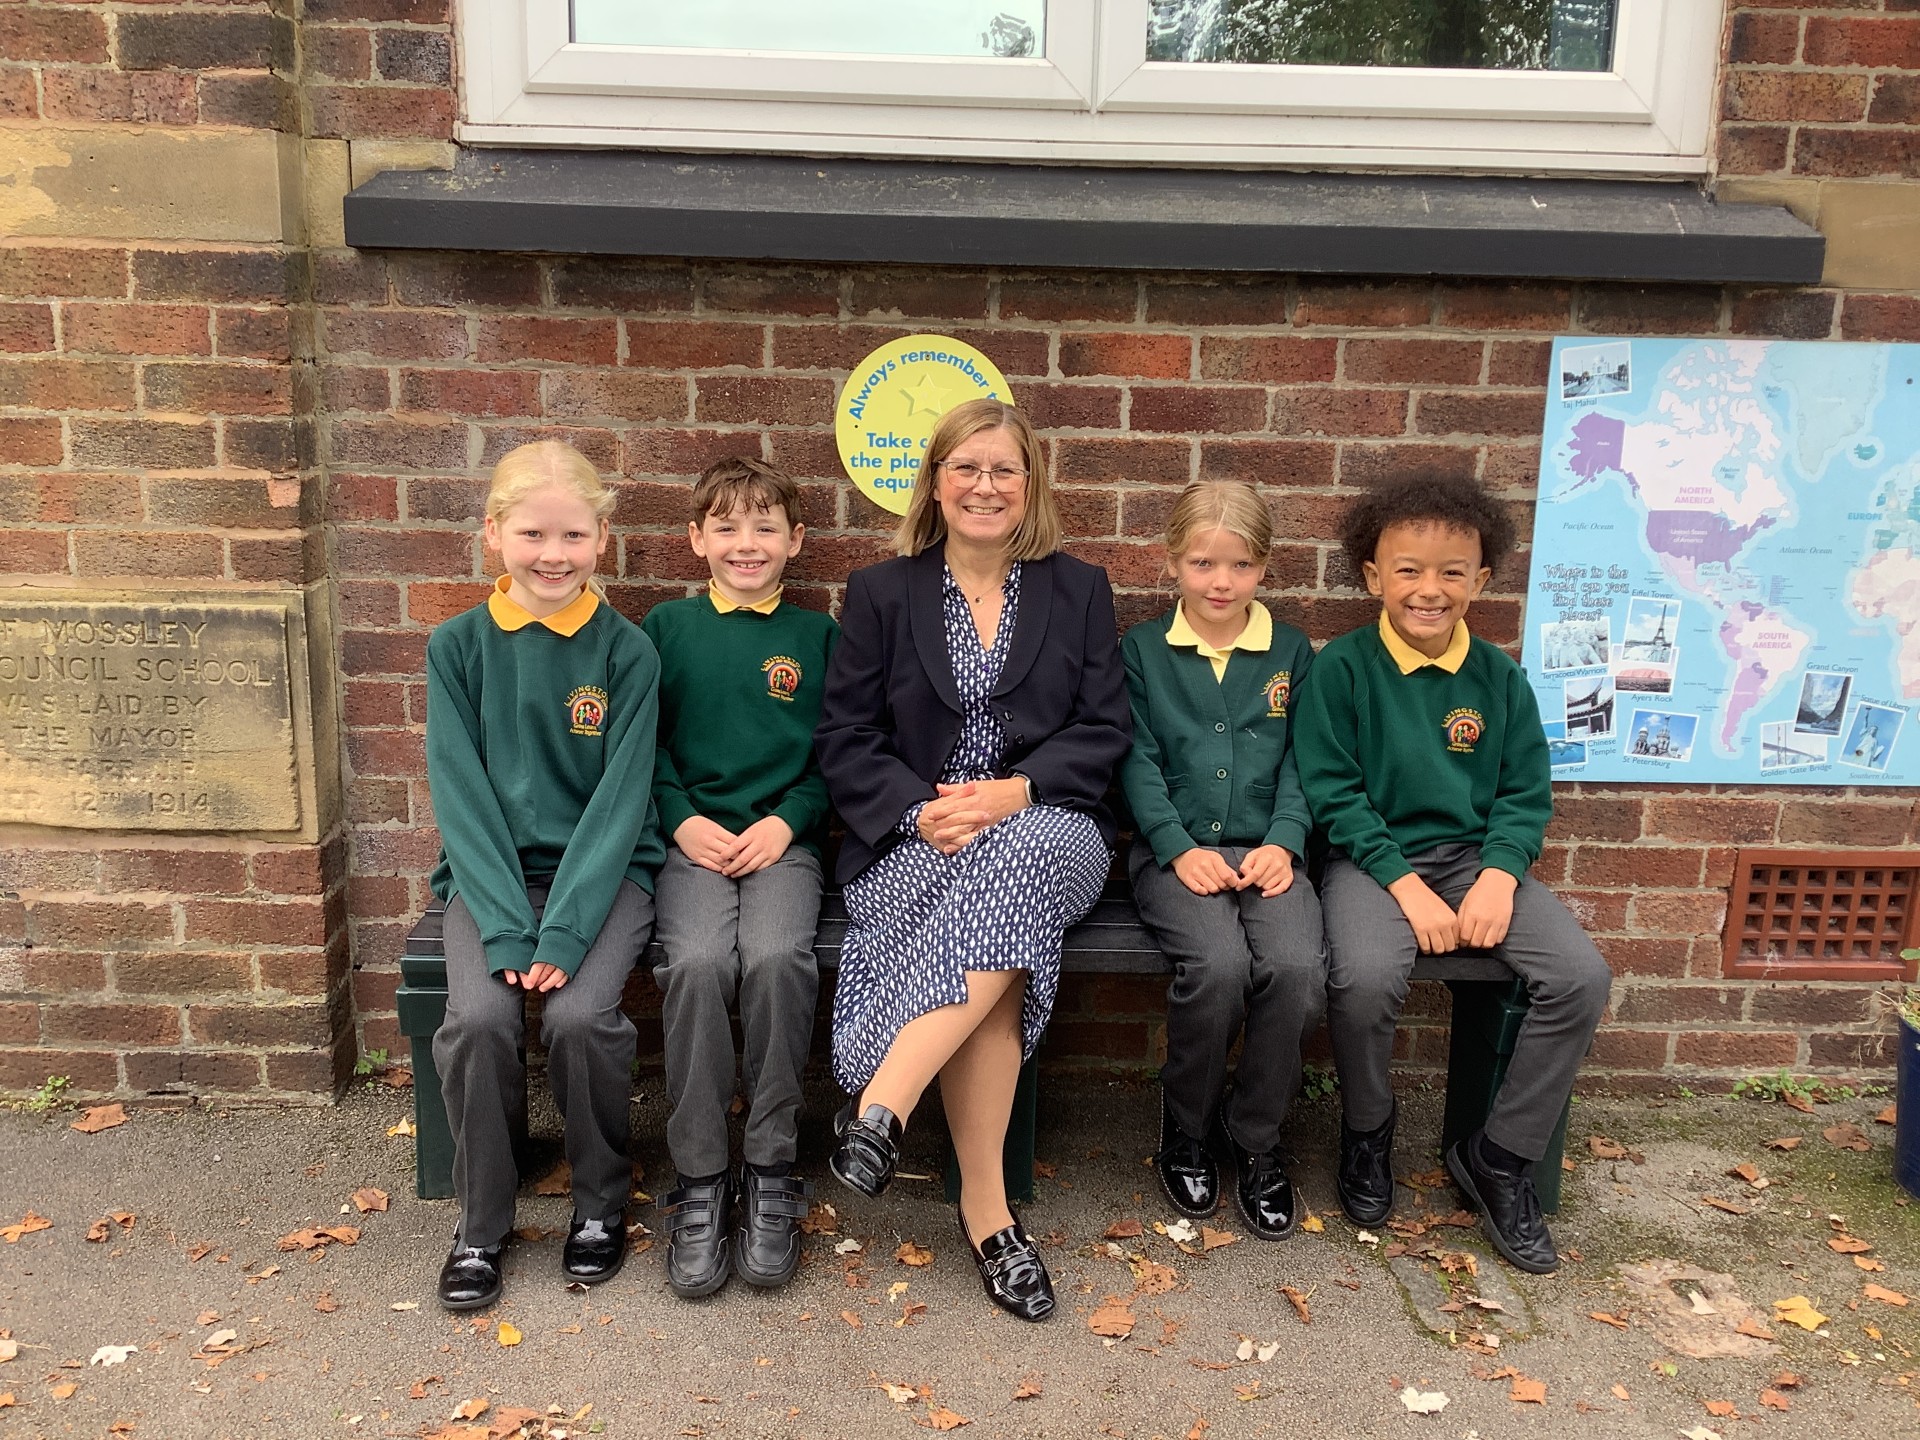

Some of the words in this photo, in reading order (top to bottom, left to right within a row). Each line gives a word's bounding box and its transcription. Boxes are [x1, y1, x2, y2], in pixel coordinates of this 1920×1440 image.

[849, 359, 896, 420] Always
[900, 350, 989, 388] remember
[1561, 401, 1573, 410] Taj
[1575, 398, 1597, 408] Mahal
[866, 432, 912, 449] Take
[850, 451, 882, 468] the
[1679, 486, 1712, 495] NORTH
[1674, 496, 1715, 504] AMERICA
[1848, 512, 1882, 521] EUROPE
[1563, 522, 1588, 531] Pacific
[1590, 522, 1614, 530] Ocean
[1779, 546, 1808, 555] Atlantic
[1809, 546, 1833, 555] Ocean
[1543, 563, 1588, 579] Where
[1590, 565, 1604, 579] in
[1607, 564, 1629, 579] the
[1539, 578, 1578, 593] world
[1581, 581, 1603, 593] can
[1605, 582, 1630, 596] you
[1552, 592, 1579, 607] find
[1581, 592, 1613, 607] these
[1631, 589, 1650, 598] Eiffel
[1651, 590, 1674, 599] Tower
[1559, 607, 1604, 624] places?
[43, 619, 207, 648] MOSSLEY
[1757, 632, 1790, 641] SOUTH
[1752, 641, 1792, 650] AMERICA
[0, 656, 118, 683] OUNCIL
[136, 657, 273, 686] SCHOOL
[1806, 662, 1830, 672] Grand
[1831, 663, 1858, 674] Canyon
[1541, 669, 1576, 680] Terracotta
[75, 694, 141, 715] LAID
[162, 695, 208, 715] BY
[1631, 694, 1653, 703] Ayers
[1655, 695, 1674, 703] Rock
[1860, 694, 1881, 706] Statue
[1889, 700, 1911, 712] Liberty
[1587, 738, 1617, 748] Chinese
[1590, 747, 1617, 757] Temple
[1622, 756, 1631, 764] St
[1632, 757, 1671, 769] Petersburg
[1551, 768, 1568, 776] rrier
[1569, 765, 1585, 774] Reef
[1760, 767, 1787, 778] Golden
[1790, 765, 1807, 775] Gate
[1809, 763, 1833, 773] Bridge
[148, 791, 209, 816] 1914
